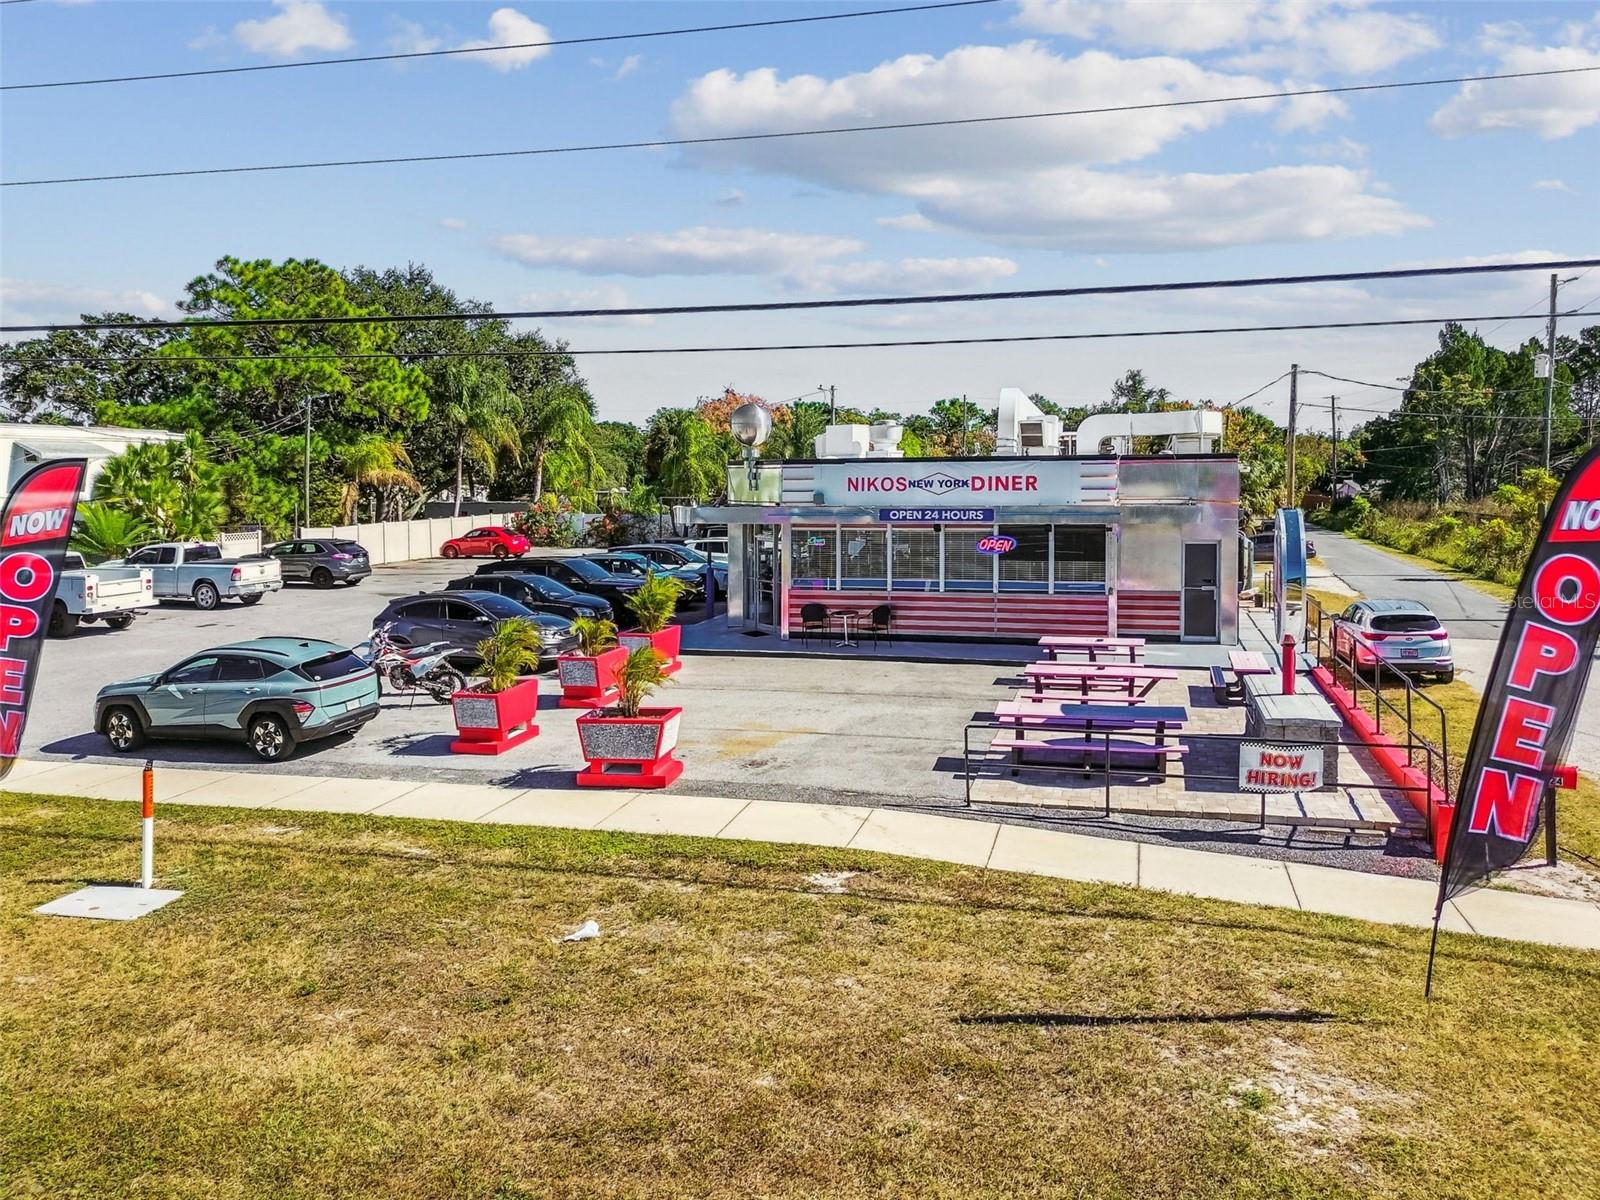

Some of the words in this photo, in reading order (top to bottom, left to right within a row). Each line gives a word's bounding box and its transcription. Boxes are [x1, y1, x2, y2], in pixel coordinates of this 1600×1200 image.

[847, 477, 907, 492] NIKOS
[908, 479, 935, 489] NEW
[937, 479, 969, 489] YORK
[971, 476, 1037, 492] DINER
[9, 508, 67, 538] NOW
[889, 510, 923, 520] OPEN
[924, 510, 939, 520] 24
[942, 510, 984, 520] HOURS
[1561, 500, 1600, 531] NO
[979, 538, 1012, 552] OPEN
[1467, 553, 1600, 843] OPEN
[1260, 751, 1304, 770] NOW
[1245, 769, 1317, 788] HIRING!
